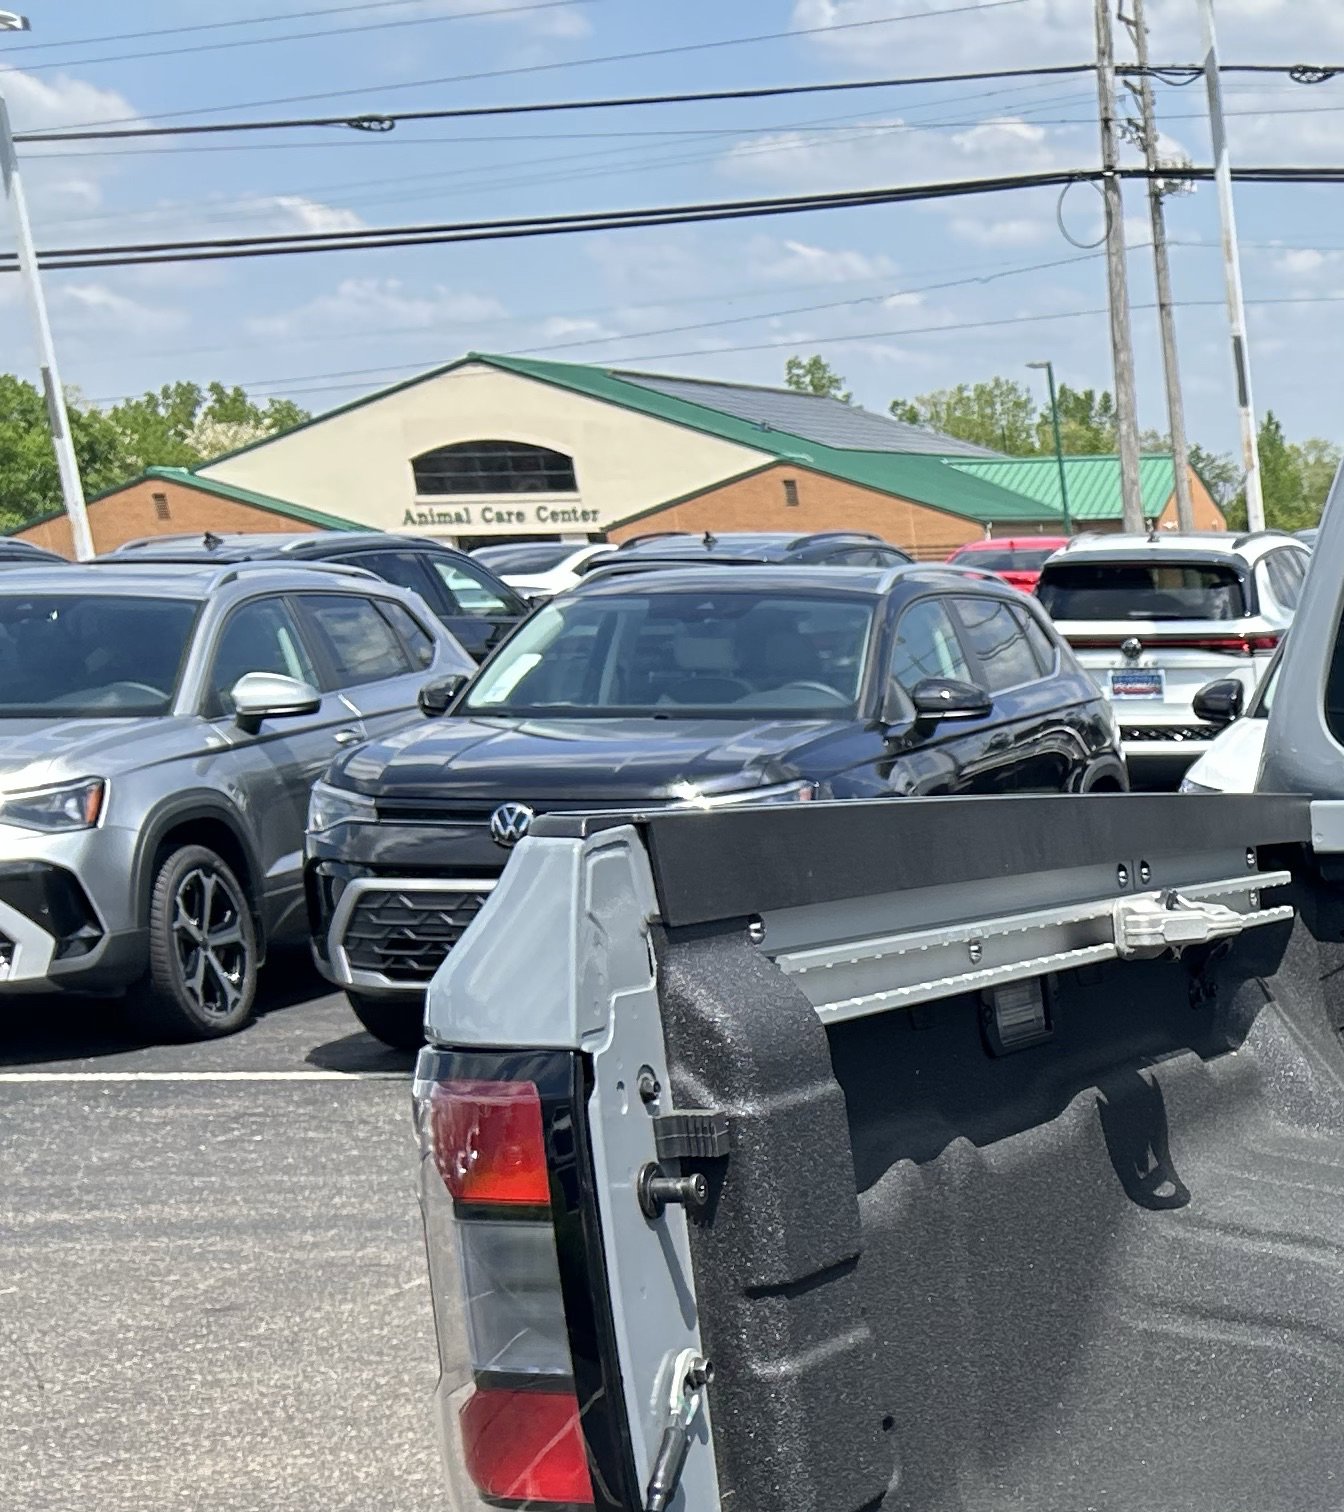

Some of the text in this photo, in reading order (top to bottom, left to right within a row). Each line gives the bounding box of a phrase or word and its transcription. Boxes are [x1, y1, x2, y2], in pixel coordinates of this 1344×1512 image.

[402, 505, 600, 525] Animal Care Center
[492, 804, 531, 841] VW
